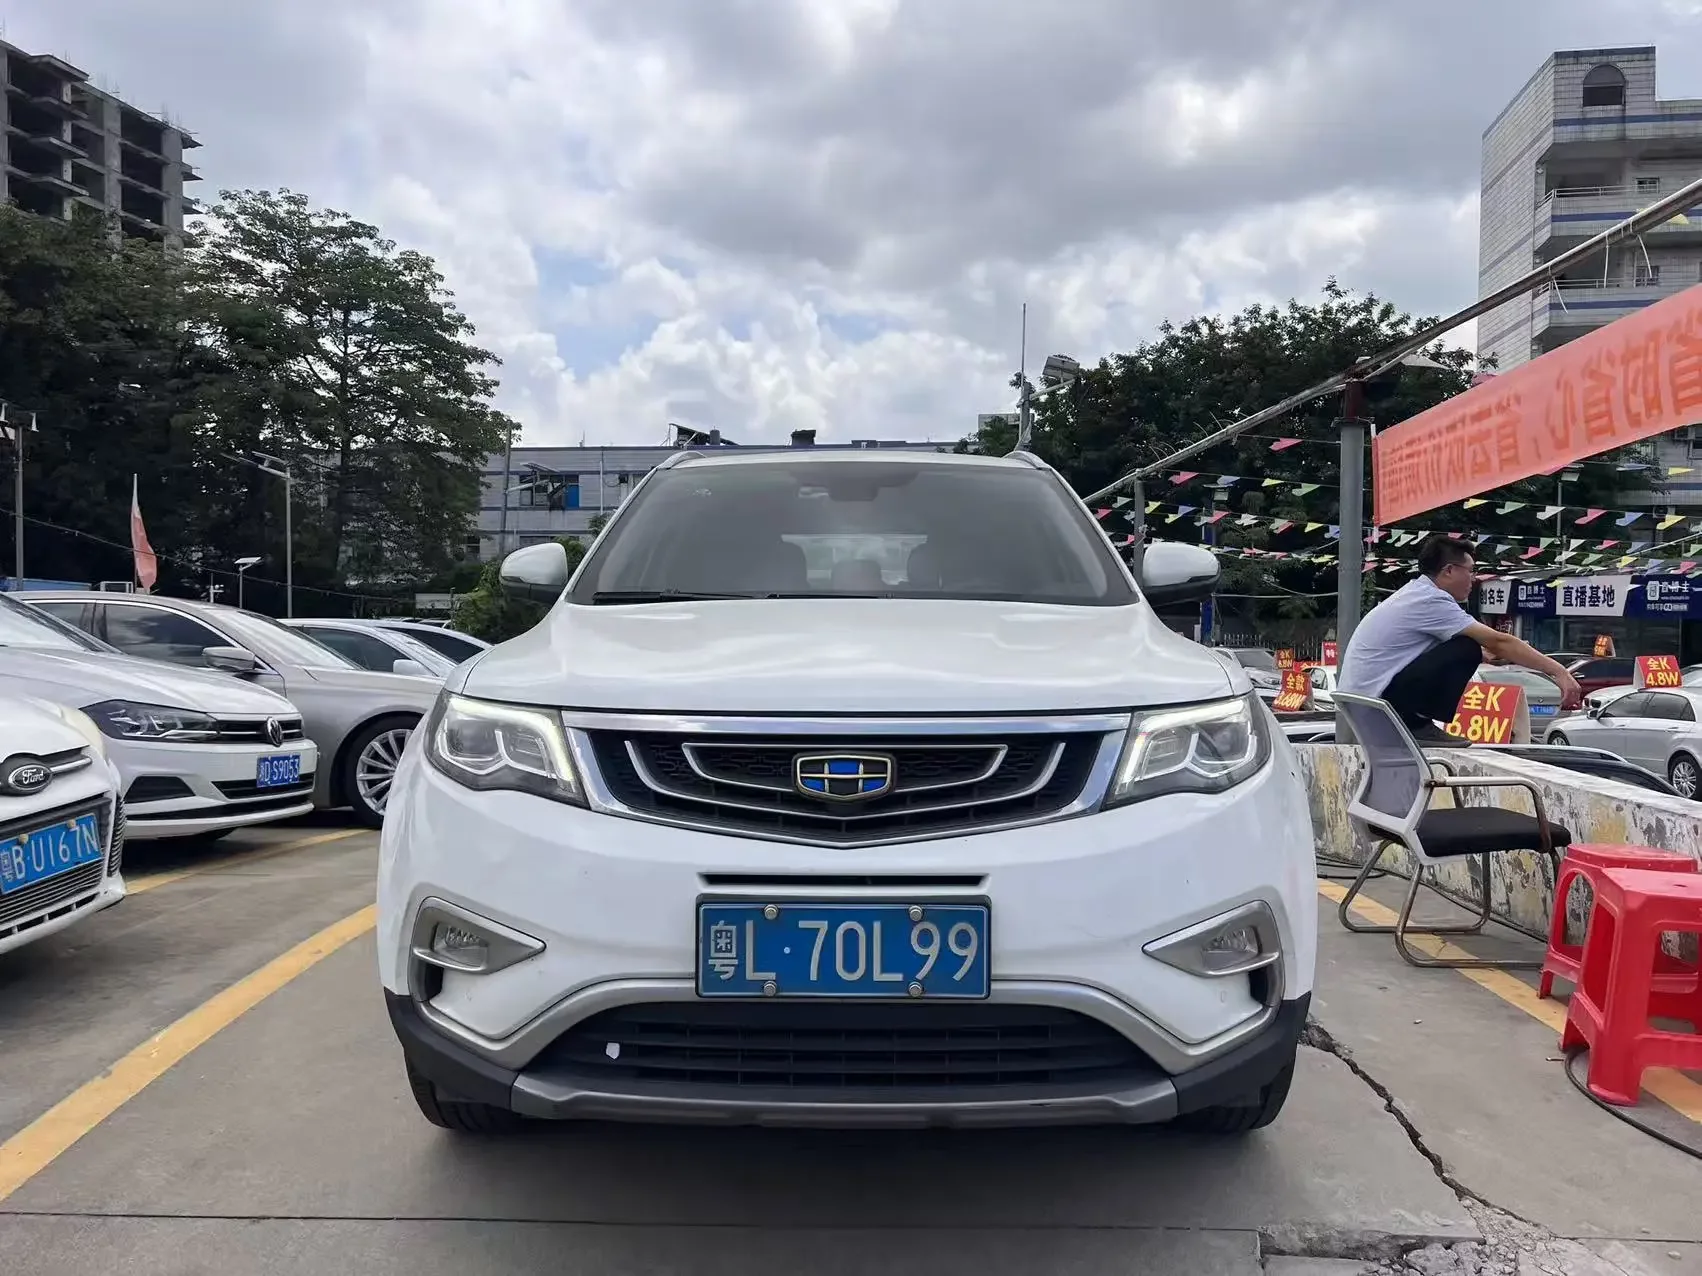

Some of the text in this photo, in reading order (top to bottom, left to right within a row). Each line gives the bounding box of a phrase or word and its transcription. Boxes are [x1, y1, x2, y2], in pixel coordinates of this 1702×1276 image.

[1562, 584, 1615, 608] 直播基地
[1647, 658, 1671, 670] 全K
[1286, 673, 1305, 691] 全款
[1646, 672, 1678, 686] 4.8W
[1462, 685, 1506, 712] 全K
[1446, 713, 1509, 743] 6.8W
[22, 768, 45, 784] Ford
[708, 920, 979, 982] 粤L·70L99
